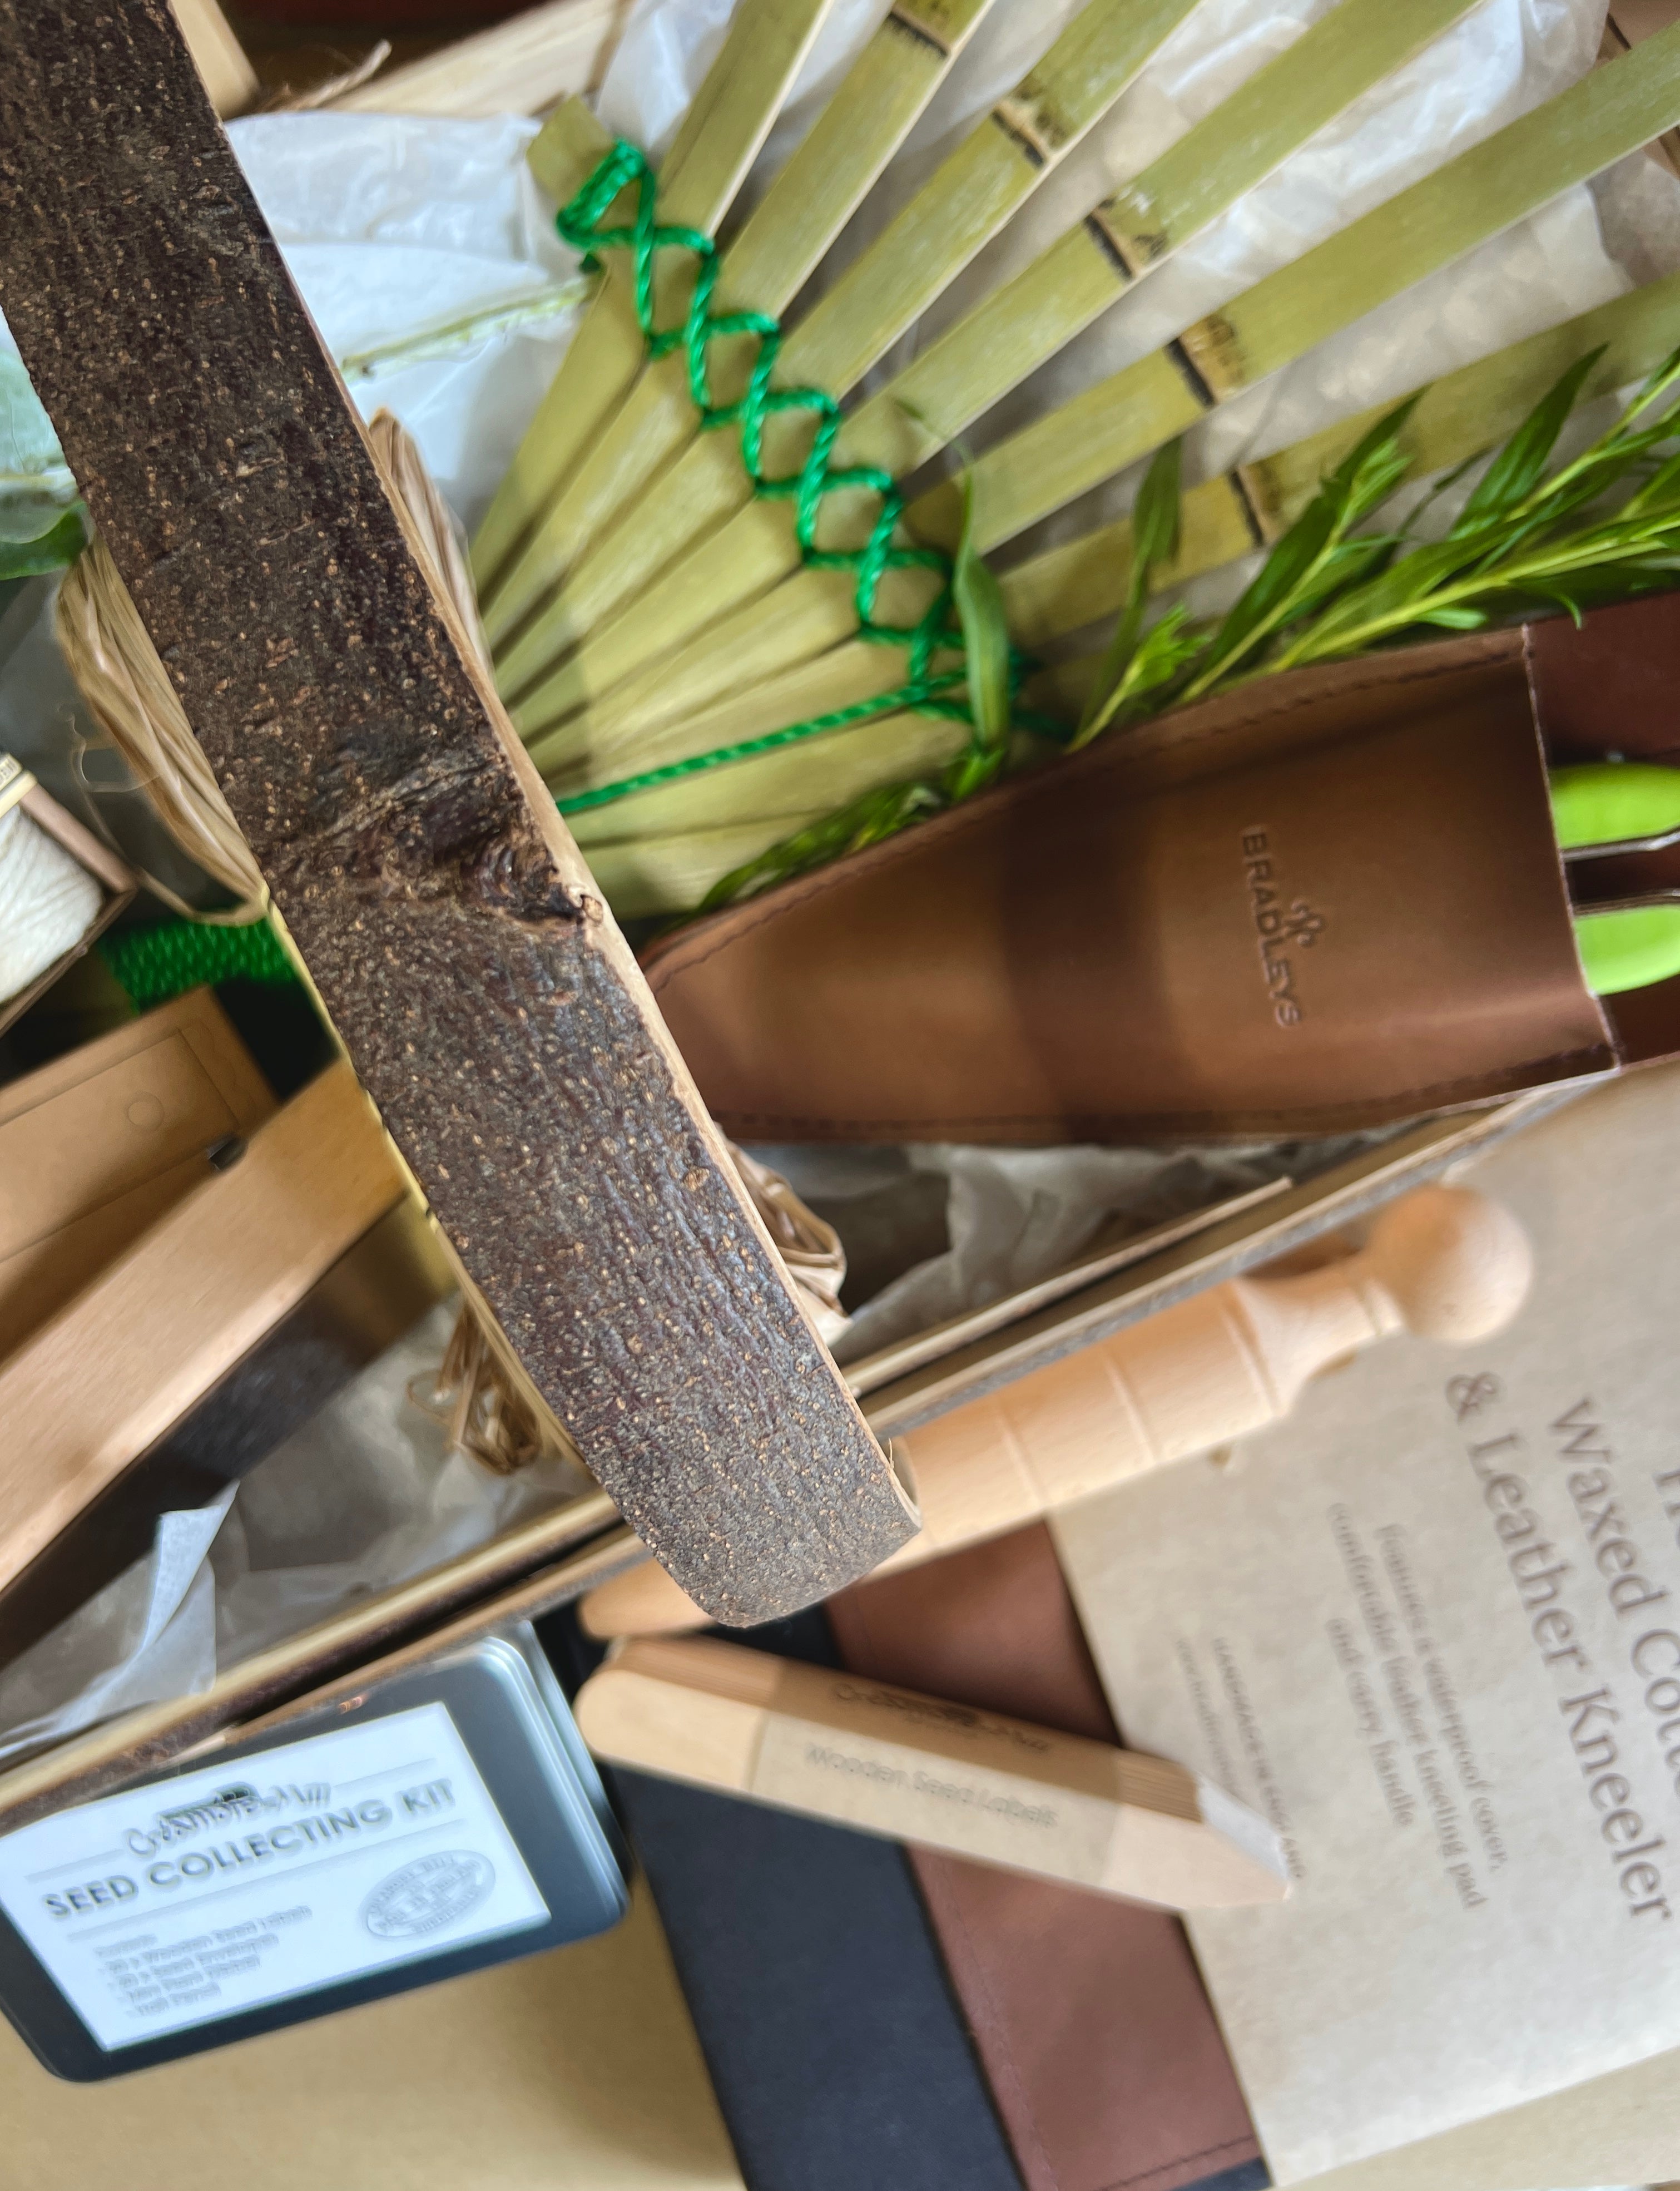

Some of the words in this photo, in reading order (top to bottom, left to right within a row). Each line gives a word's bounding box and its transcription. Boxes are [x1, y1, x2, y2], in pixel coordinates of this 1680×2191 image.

[1241, 824, 1302, 1027] BRADLEYS
[1447, 1371, 1505, 1423] &
[1468, 1432, 1592, 1673] Leather
[1548, 1396, 1668, 1617] Waxed
[44, 1875, 138, 1919] SEED
[148, 1798, 392, 1890] COLLECTING
[394, 1778, 455, 1817] KIT
[1369, 1739, 1416, 1828] handle
[1381, 1656, 1429, 1745] leather
[1414, 1749, 1468, 1856] kneeling
[1445, 1863, 1489, 1908] pad
[1424, 1658, 1494, 1791] waterproof
[1469, 1797, 1508, 1873] cover,
[1559, 1685, 1672, 1921] Kneeler
